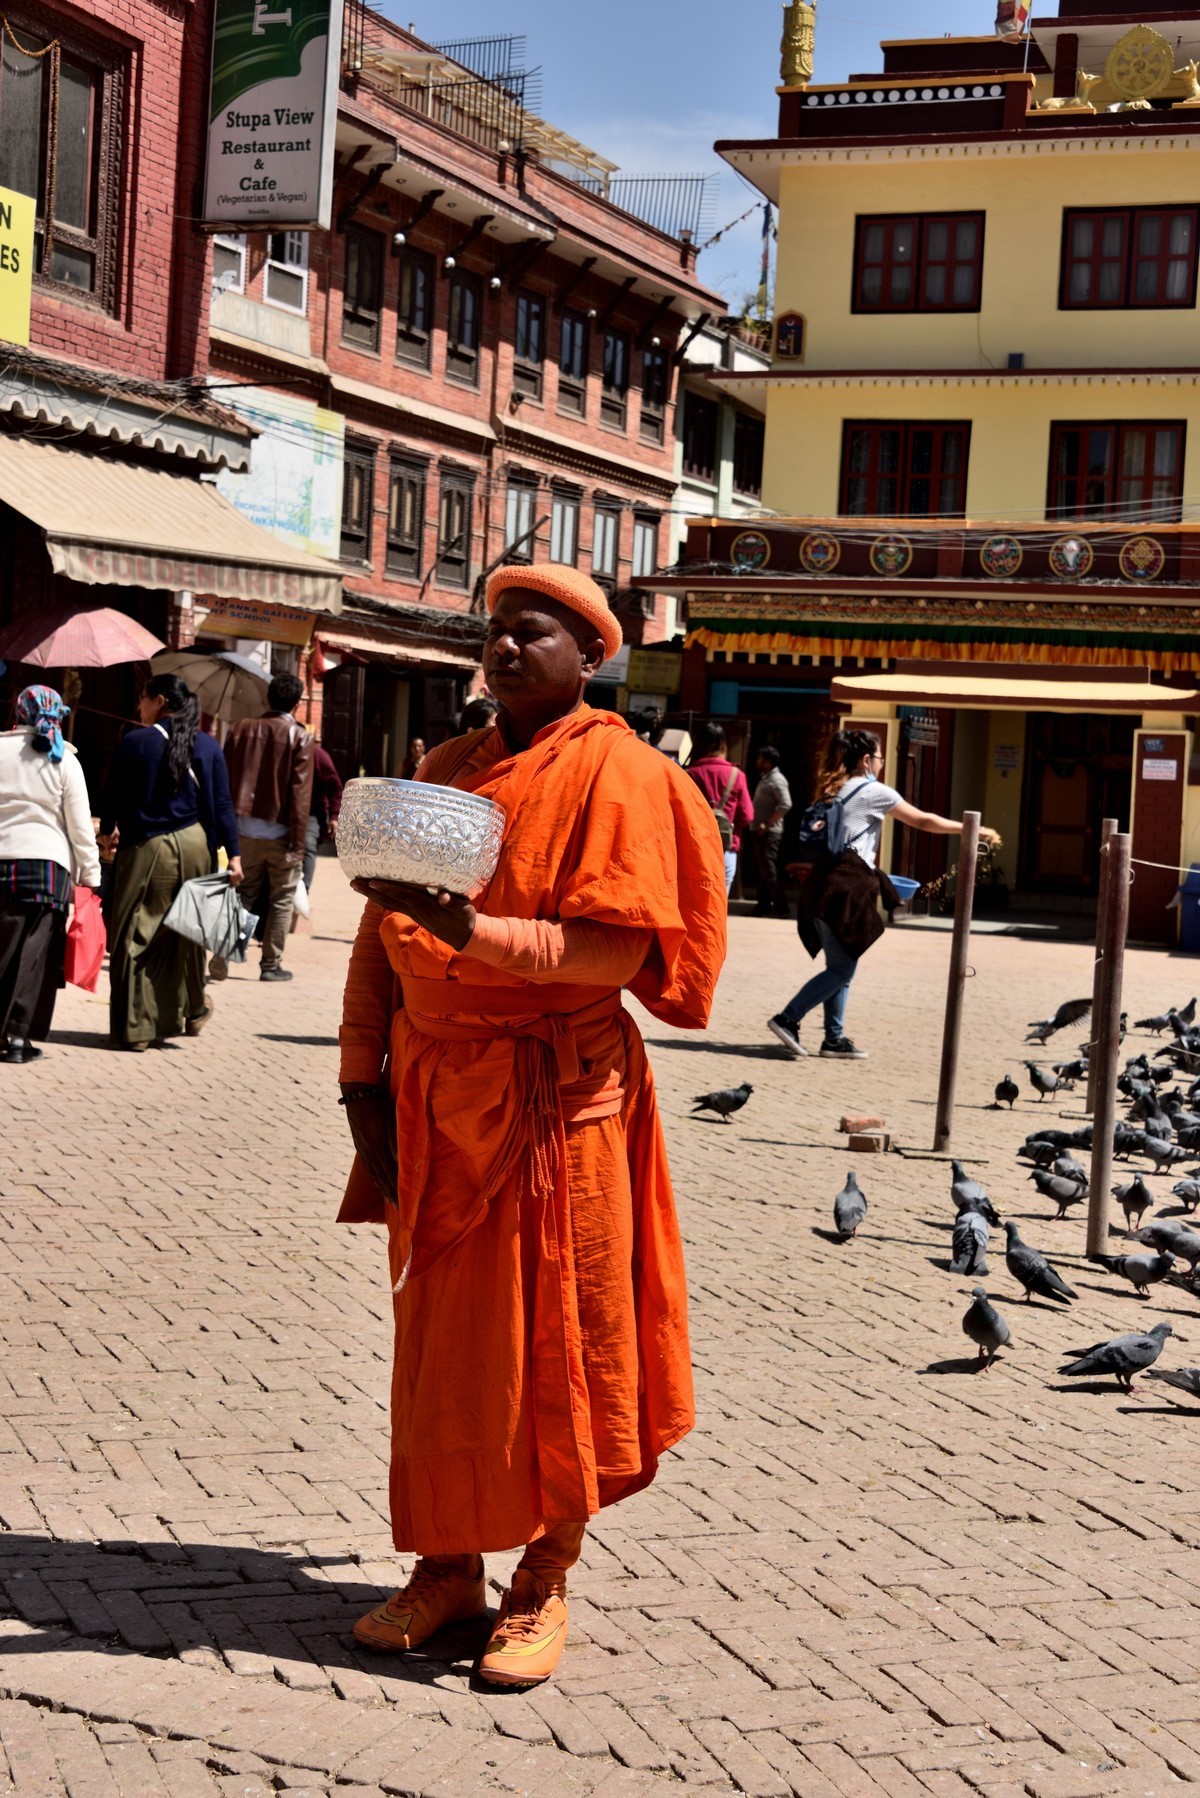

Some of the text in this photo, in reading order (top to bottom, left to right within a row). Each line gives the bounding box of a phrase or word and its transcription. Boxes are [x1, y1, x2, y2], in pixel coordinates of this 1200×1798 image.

[226, 108, 315, 132] Stupa View
[221, 137, 311, 156] Restaurant
[253, 158, 265, 170] &
[239, 176, 277, 191] Cafe
[216, 191, 308, 206] (Vegetarian & Vegan)
[86, 550, 299, 602] GOLDEN ARTS
[209, 607, 272, 624] RT SCHOOL
[262, 608, 309, 622] GALLERY
